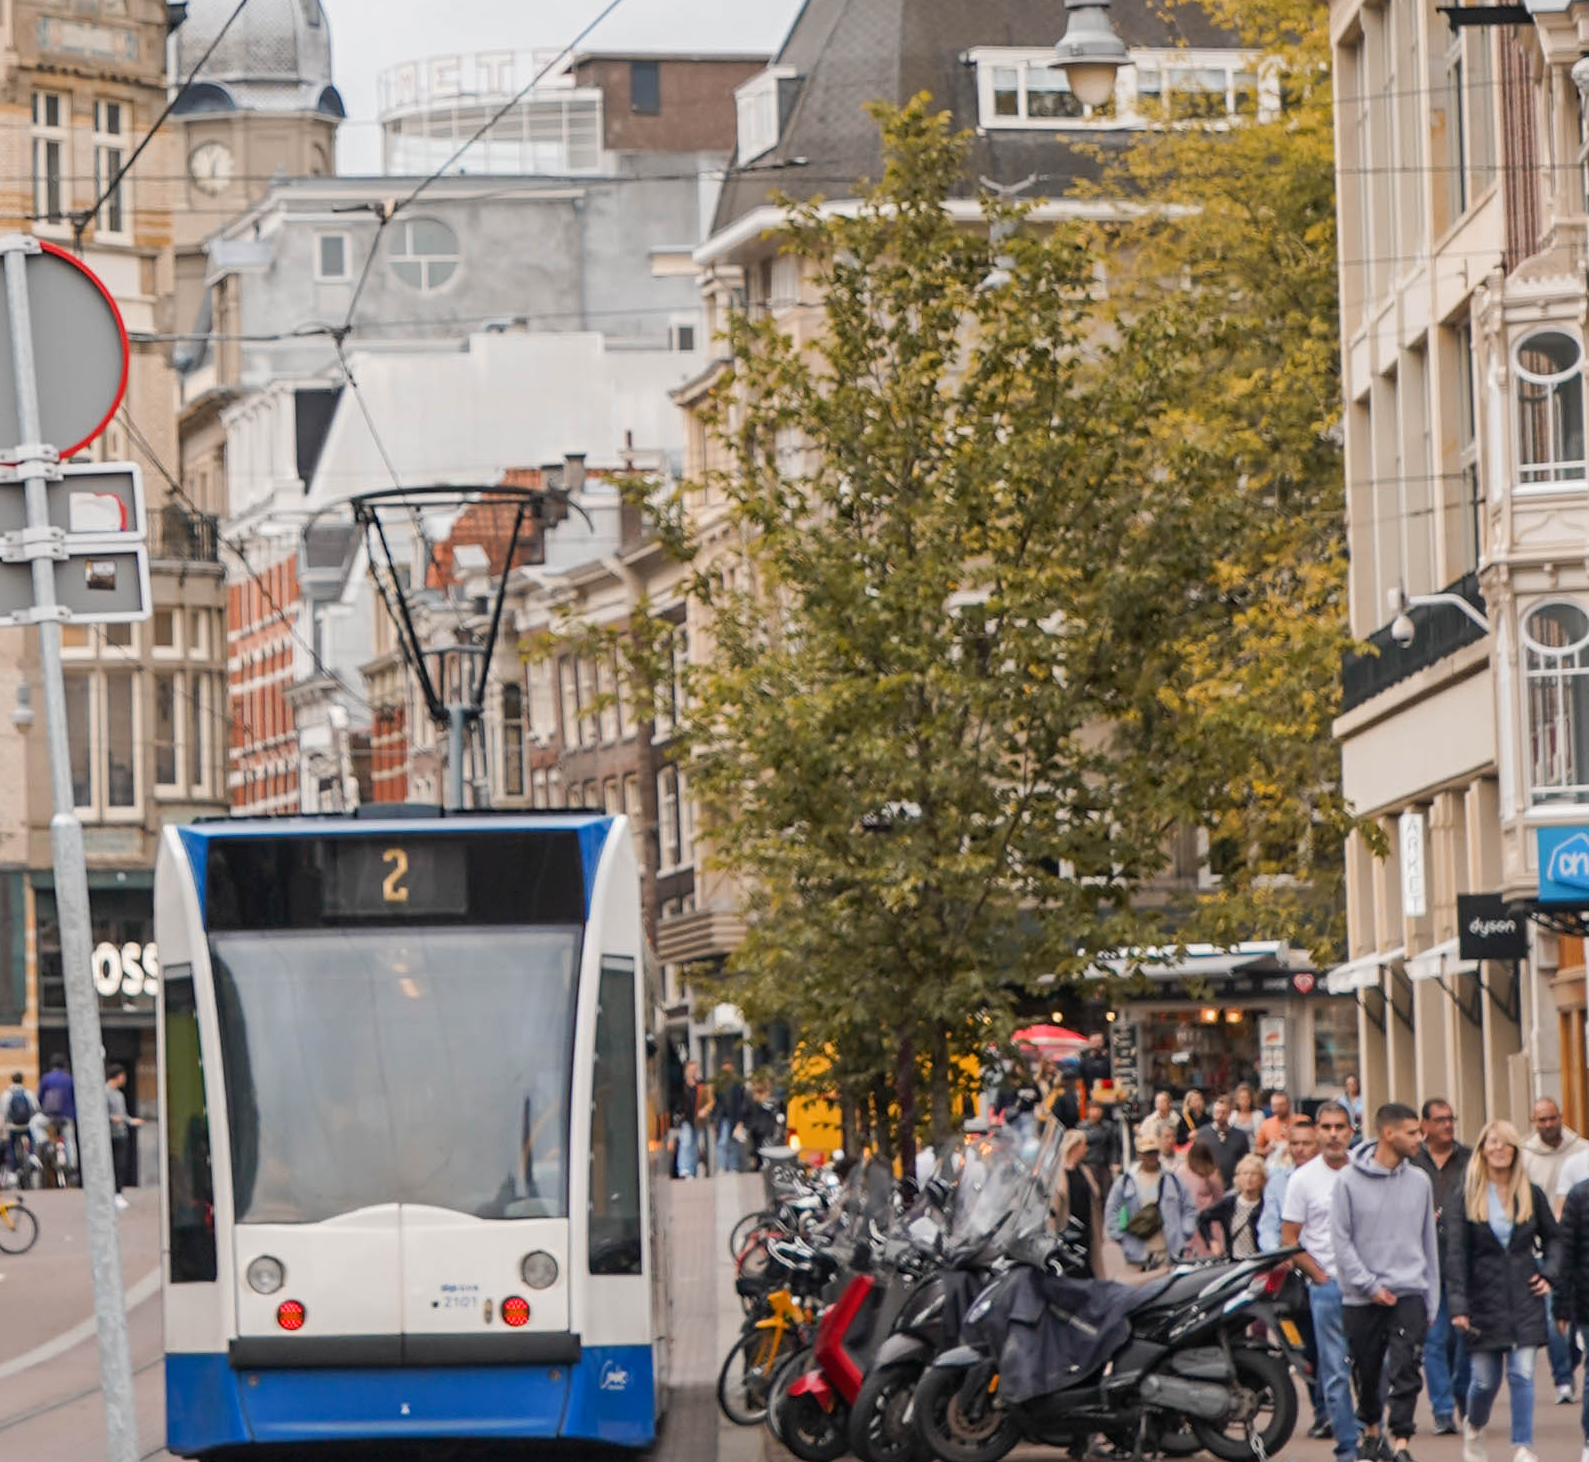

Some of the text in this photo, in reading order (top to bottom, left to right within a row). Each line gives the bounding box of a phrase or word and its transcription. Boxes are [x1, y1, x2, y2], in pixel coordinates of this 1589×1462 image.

[383, 848, 408, 902] 2
[1469, 917, 1515, 938] dyson
[92, 941, 159, 997] OSS
